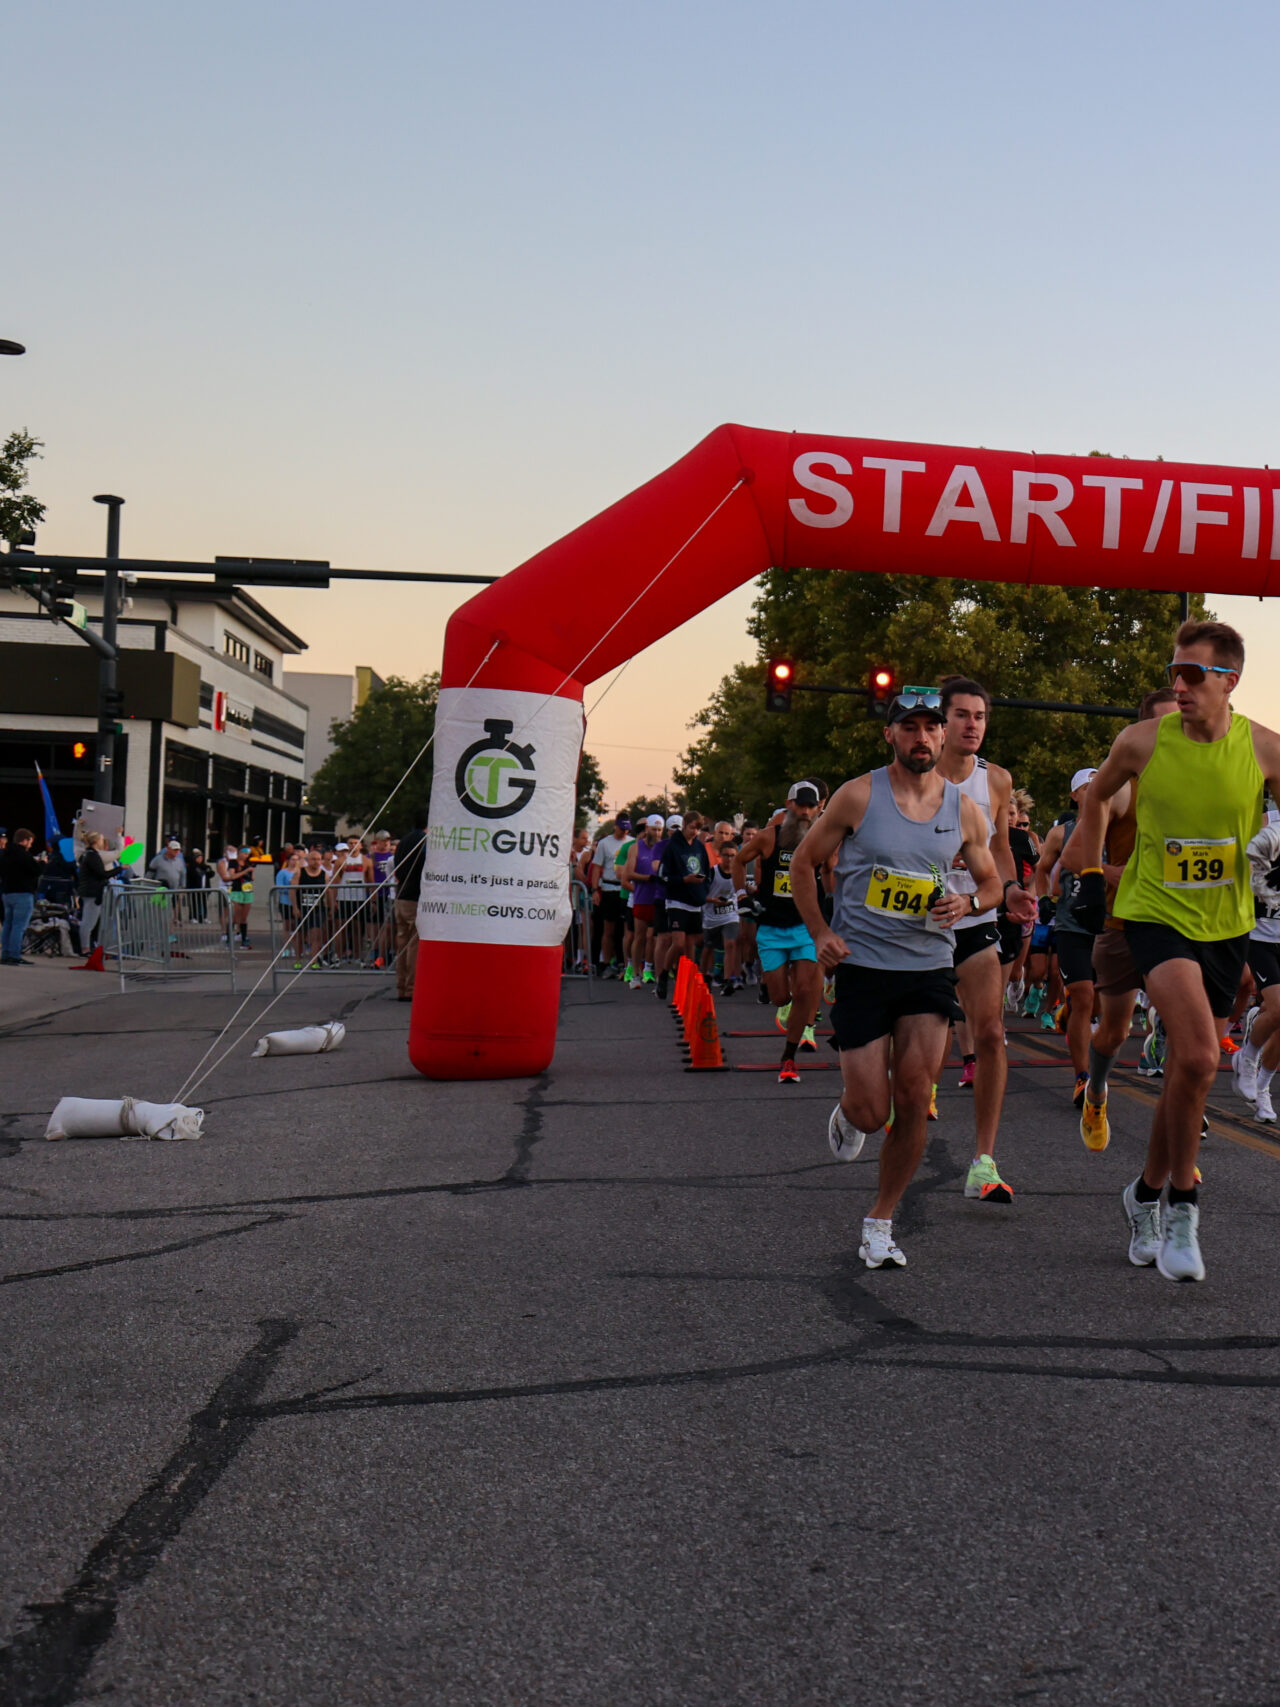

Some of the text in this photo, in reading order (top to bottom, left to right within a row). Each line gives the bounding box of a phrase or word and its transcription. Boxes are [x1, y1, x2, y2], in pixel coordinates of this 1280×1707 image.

[430, 825, 560, 858] TIMERGUYS
[451, 874, 467, 885] us,
[470, 873, 488, 884] it's
[489, 874, 514, 887] just
[516, 878, 524, 886] a
[1177, 858, 1224, 881] 139
[421, 902, 556, 921] WWW.TIMERGUYS.COM
[881, 887, 922, 914] 194
